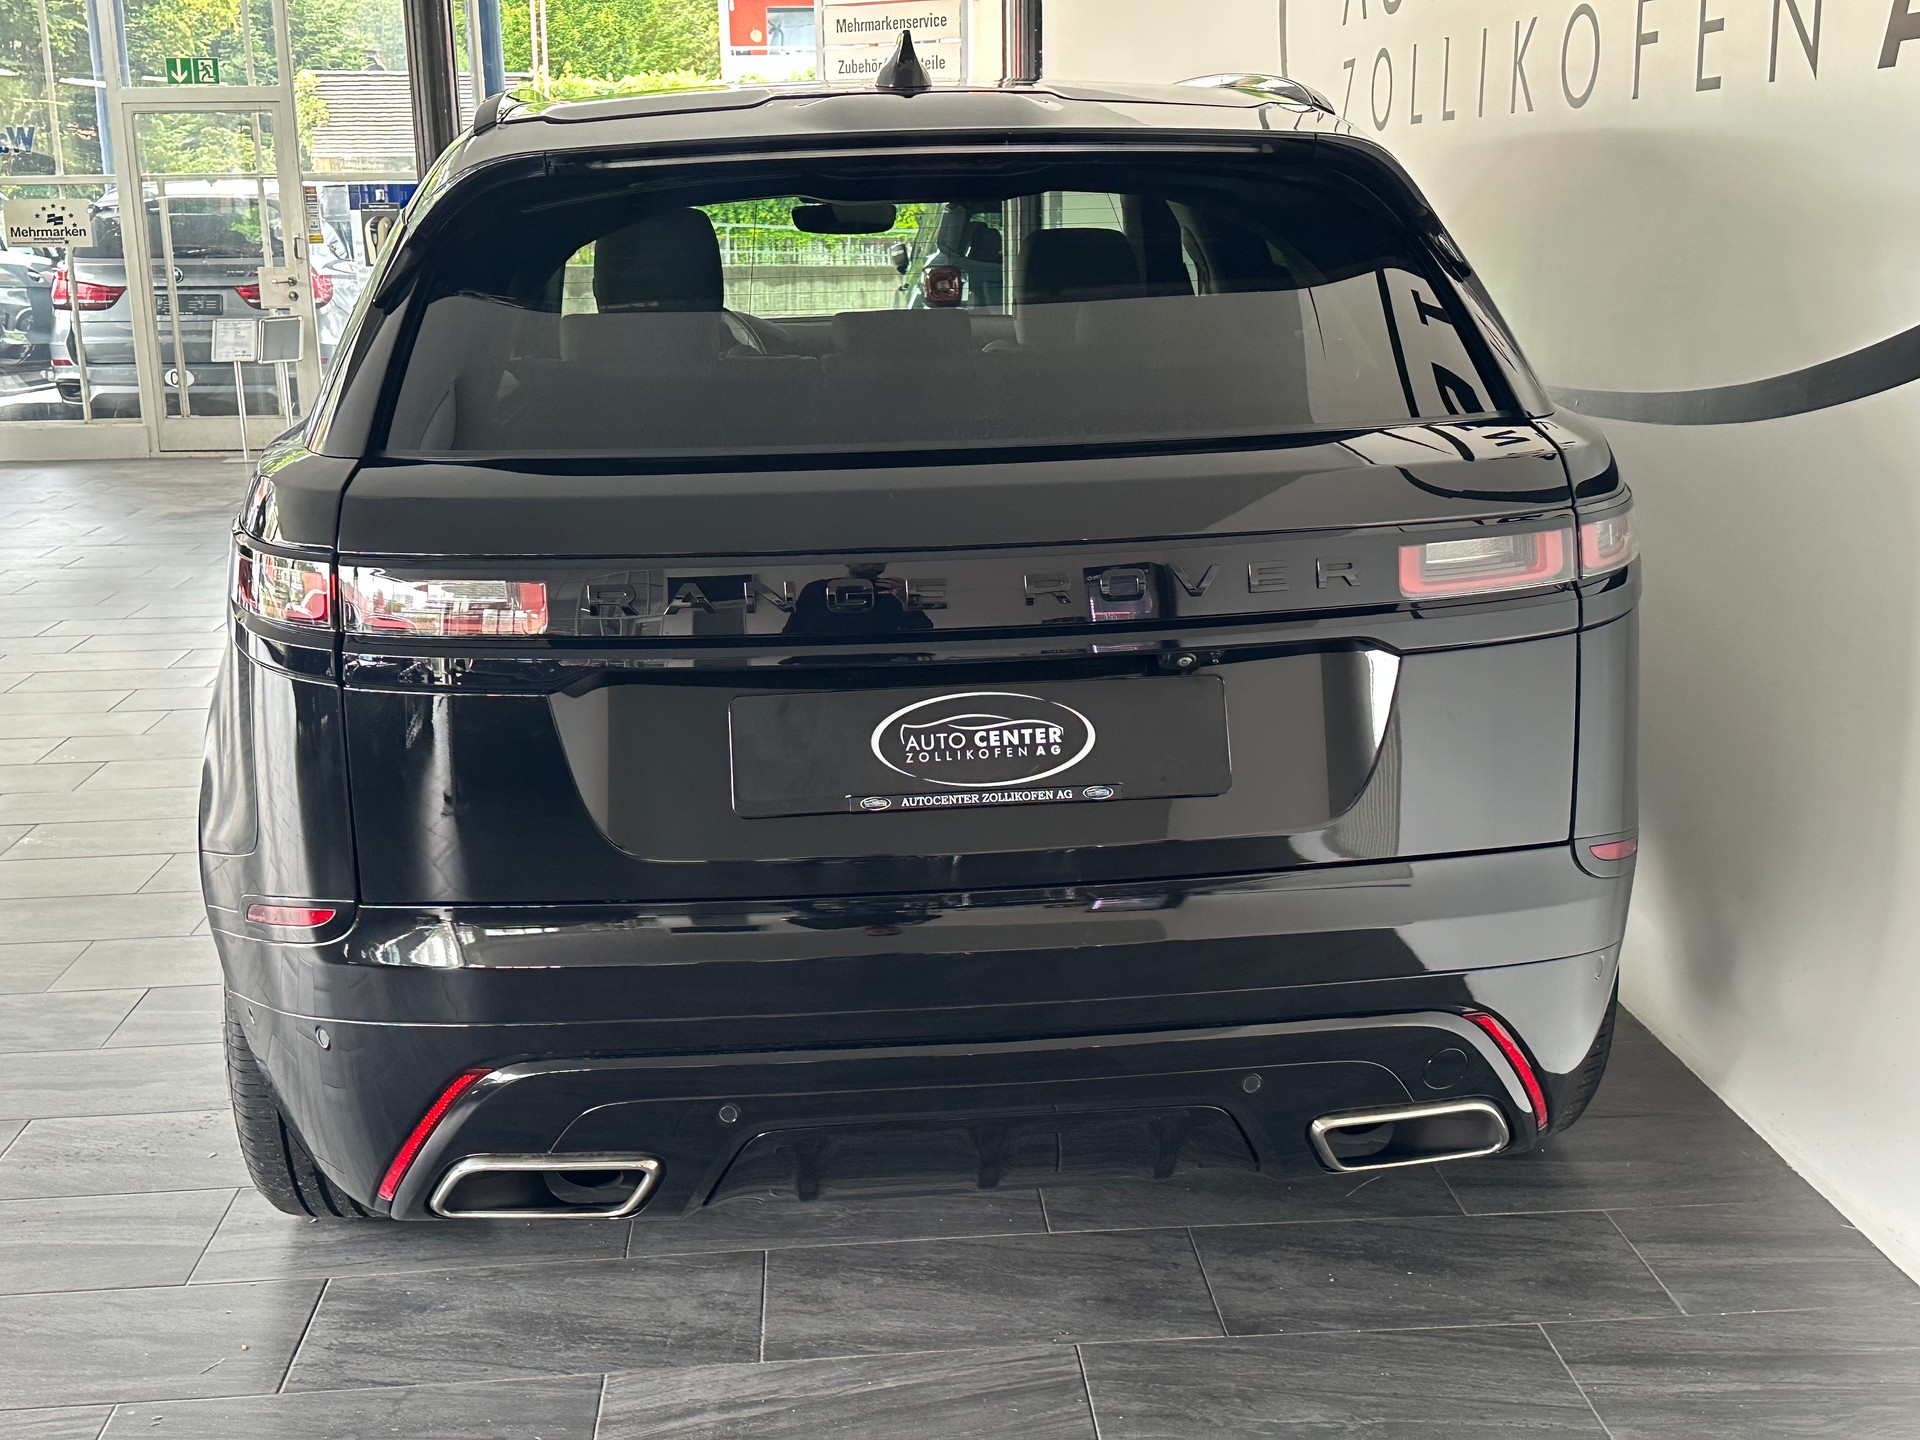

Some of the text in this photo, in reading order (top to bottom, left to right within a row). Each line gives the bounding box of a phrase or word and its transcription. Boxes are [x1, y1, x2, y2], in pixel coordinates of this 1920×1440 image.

[836, 13, 948, 34] Mehrmarkenservice
[1342, 0, 1820, 131] ZOLLIKOFEN
[10, 226, 87, 238] Mehrmarken
[586, 556, 1362, 616] RANGE ROVER
[905, 727, 1063, 752] AUTO CENTER
[905, 744, 1062, 764] ZOLLIKOFEN AG
[901, 794, 980, 807] AUTOCENTER
[982, 790, 1055, 803] ZOLLIKOFEN
[1056, 789, 1074, 800] AG
